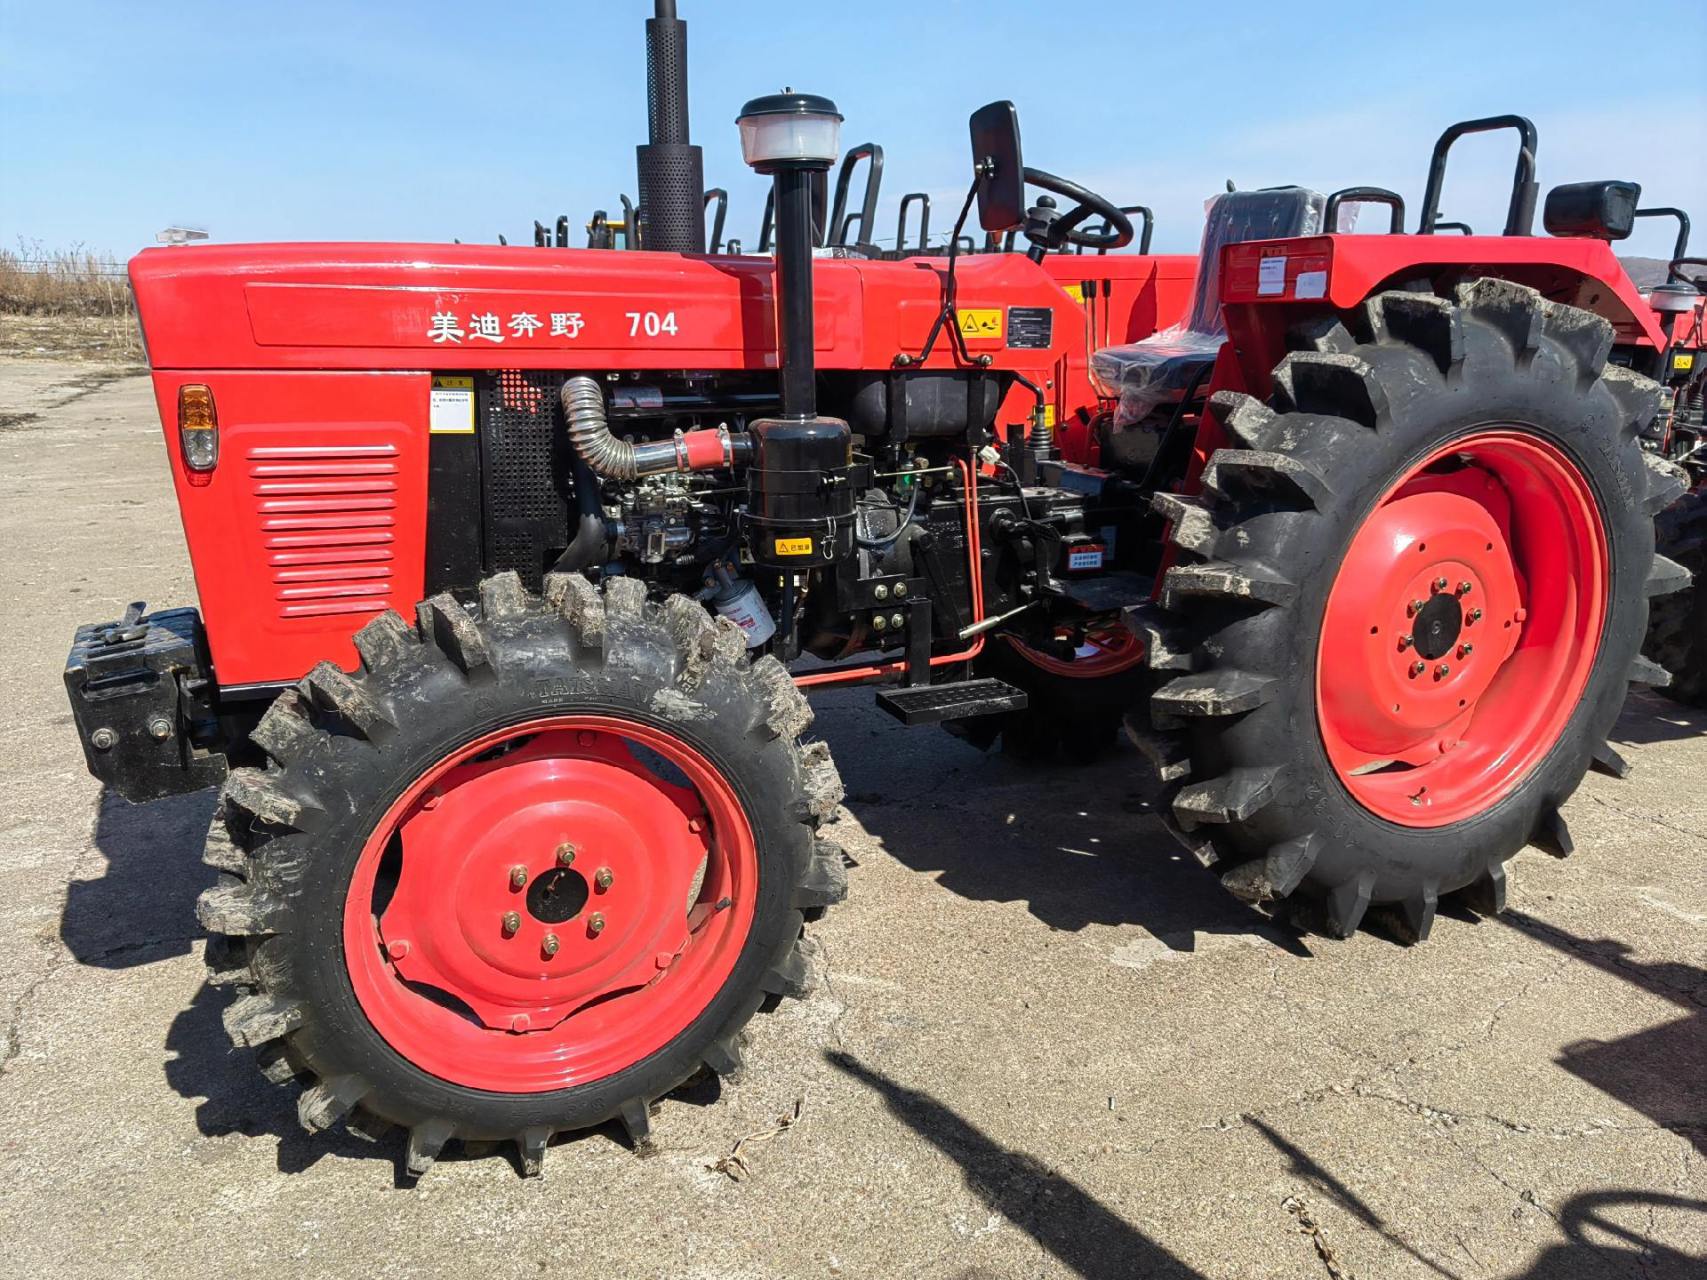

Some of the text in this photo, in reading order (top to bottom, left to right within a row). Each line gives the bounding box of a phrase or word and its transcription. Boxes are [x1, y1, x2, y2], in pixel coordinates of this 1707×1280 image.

[426, 311, 679, 343] 美迪奔野 704
